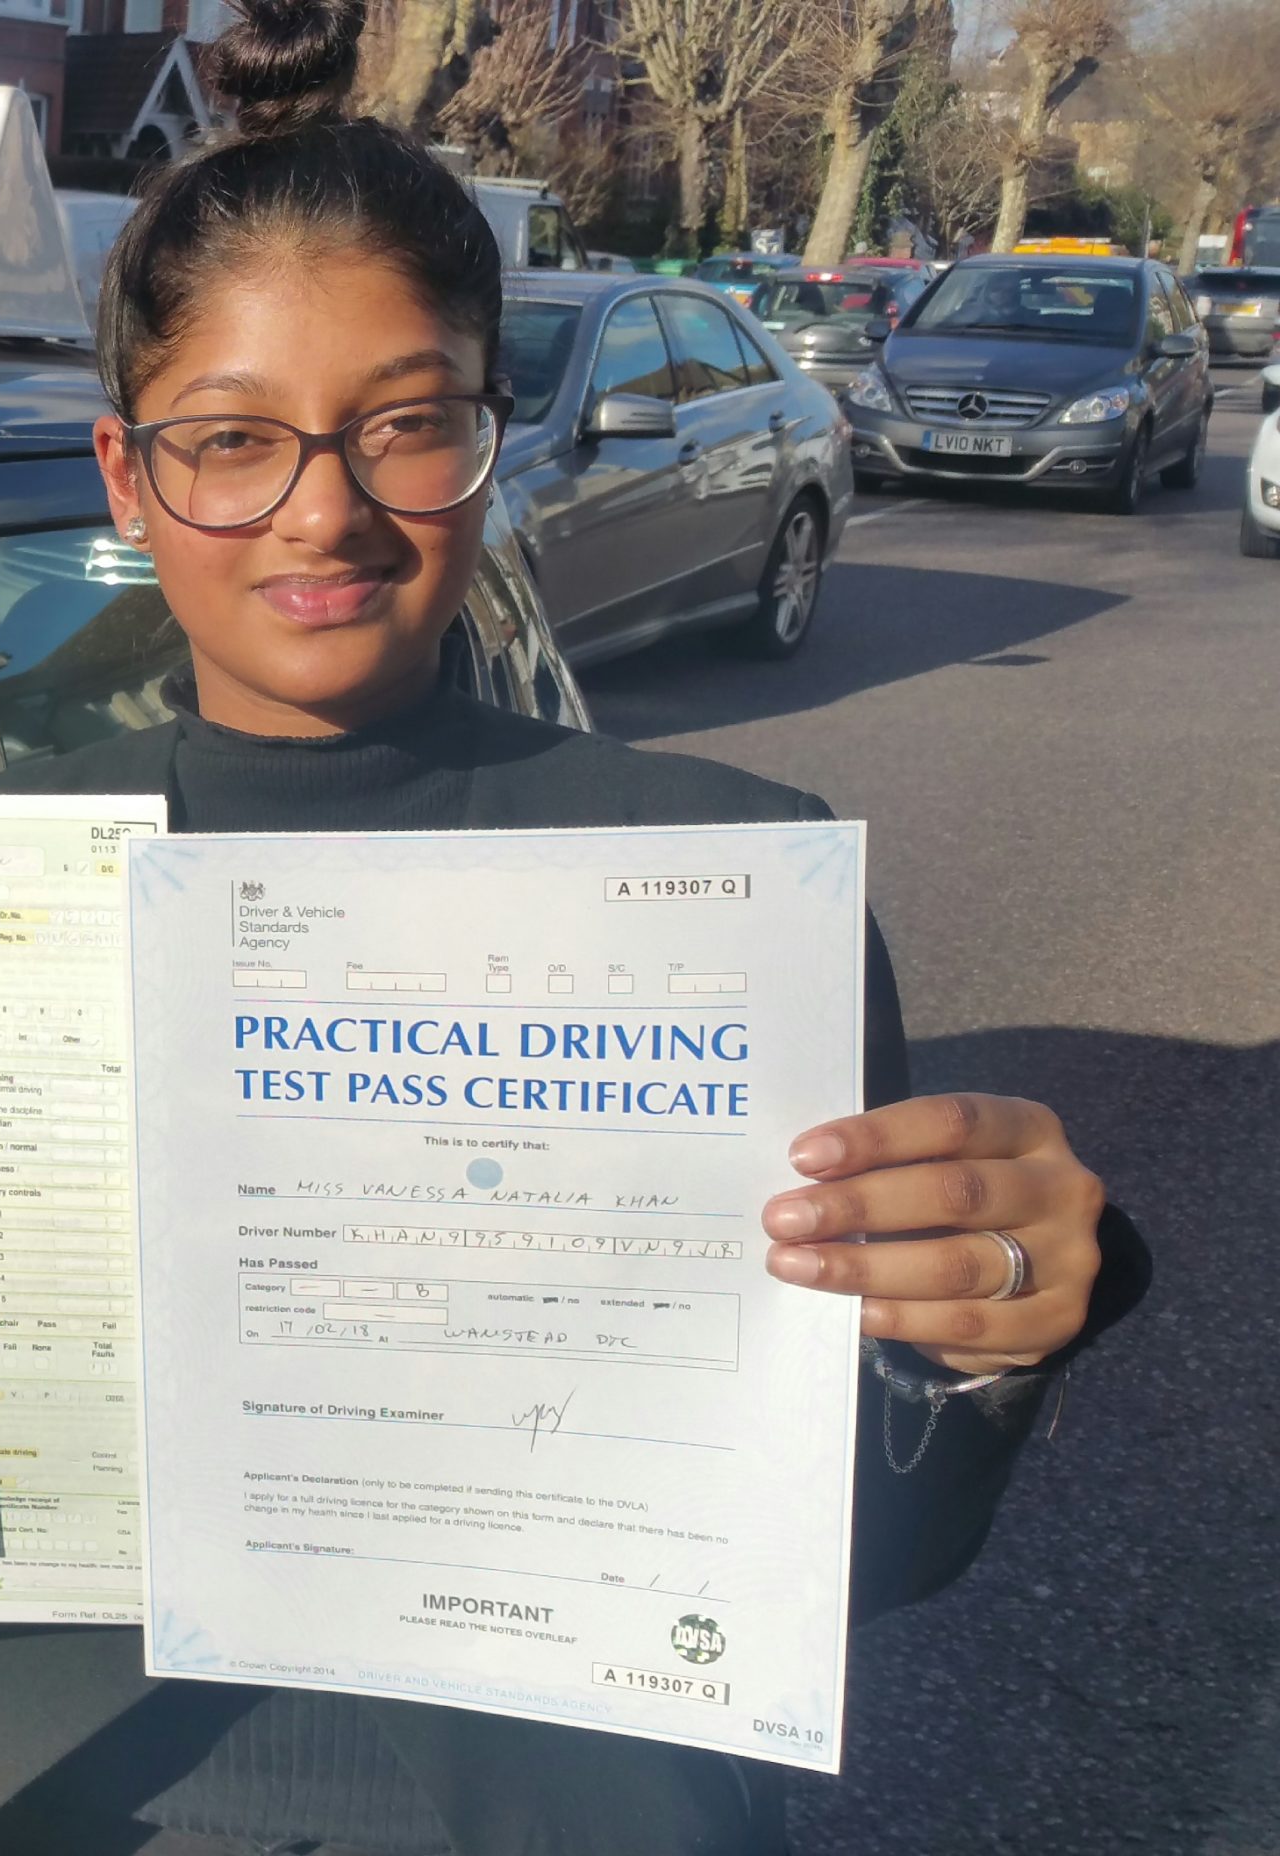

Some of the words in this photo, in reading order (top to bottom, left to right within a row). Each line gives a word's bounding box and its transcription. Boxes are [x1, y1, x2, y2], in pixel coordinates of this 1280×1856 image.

[934, 434, 968, 450] LV10
[972, 437, 1004, 452] NKT
[618, 882, 631, 895] A
[641, 879, 712, 896] 119307
[721, 879, 736, 895] Q
[239, 905, 278, 918] Driver
[283, 906, 292, 918] &
[298, 906, 345, 918] Vehicle
[239, 921, 309, 934] Standards
[239, 936, 290, 951] Agency
[232, 960, 255, 968] Issue
[258, 960, 272, 968] No.
[488, 954, 509, 962] Rem
[346, 962, 363, 970] Fee
[488, 963, 509, 974] Type
[548, 964, 567, 973] O/D
[608, 963, 625, 972] S/C
[668, 963, 684, 972] T/P
[235, 1015, 500, 1057] PRACTICAL
[521, 1023, 748, 1061] DRIVING
[102, 1064, 122, 1073] Total
[19, 1086, 42, 1095] driving
[235, 1069, 331, 1100] TEST
[349, 1072, 447, 1106] PASS
[464, 1076, 749, 1116] CERTIFICATE
[424, 1136, 449, 1146] This
[453, 1136, 463, 1147] is
[467, 1138, 478, 1147] to
[482, 1139, 519, 1151] certify
[522, 1141, 550, 1151] that:
[238, 1184, 276, 1195] Name
[297, 1180, 344, 1196] MISS
[363, 1184, 469, 1202] VANESSA
[490, 1191, 593, 1206] NATALIA
[615, 1194, 679, 1209] KHAN
[238, 1225, 279, 1237] Driver
[283, 1226, 336, 1238] Number
[239, 1257, 264, 1268] Has
[269, 1258, 318, 1269] Passed
[245, 1283, 286, 1293] Category
[488, 1293, 534, 1302] automatic
[600, 1298, 645, 1308] extended
[245, 1305, 291, 1314] restriction
[294, 1305, 316, 1314] code
[38, 1320, 57, 1328] Pass
[246, 1329, 259, 1338] On
[379, 1335, 388, 1343] At
[444, 1327, 568, 1344] WANSTEAD
[597, 1333, 638, 1348] DTC
[242, 1400, 306, 1415] Signature
[310, 1404, 323, 1414] of
[327, 1404, 375, 1419] Driving
[380, 1408, 445, 1421] Examiner
[244, 1472, 299, 1484] Applicant's
[302, 1475, 359, 1486] Declaration
[361, 1477, 385, 1489] (only
[387, 1480, 397, 1488] to
[399, 1481, 411, 1489] be
[413, 1482, 463, 1494] completed
[466, 1485, 472, 1493] if
[474, 1486, 513, 1498] sending
[516, 1489, 533, 1499] this
[536, 1492, 583, 1504] certificate
[586, 1497, 595, 1505] to
[599, 1498, 614, 1507] the
[616, 1499, 649, 1512] DVLA)
[246, 1540, 300, 1551] Applicant's
[303, 1543, 354, 1555] Signature:
[601, 1572, 625, 1583] Date
[52, 1610, 78, 1618] Form
[423, 1593, 554, 1624] IMPORTANT
[399, 1614, 437, 1626] PLEASE
[439, 1619, 467, 1630] READ
[469, 1622, 487, 1632] THE
[490, 1625, 523, 1637] NOTES
[525, 1629, 577, 1645] OVERLEAF
[239, 1660, 267, 1671] Crown
[269, 1662, 311, 1675] Copyright
[313, 1667, 336, 1677] 2014
[604, 1669, 616, 1682] A
[626, 1671, 694, 1695] 119307
[702, 1684, 716, 1700] Q
[357, 1670, 401, 1684] DRIVER
[405, 1676, 430, 1687] AND
[432, 1680, 481, 1696] VEHICLE
[485, 1685, 558, 1706] STANDARDS
[561, 1698, 612, 1715] AGENCY
[753, 1719, 800, 1739] DVSA
[805, 1728, 823, 1744] 10
